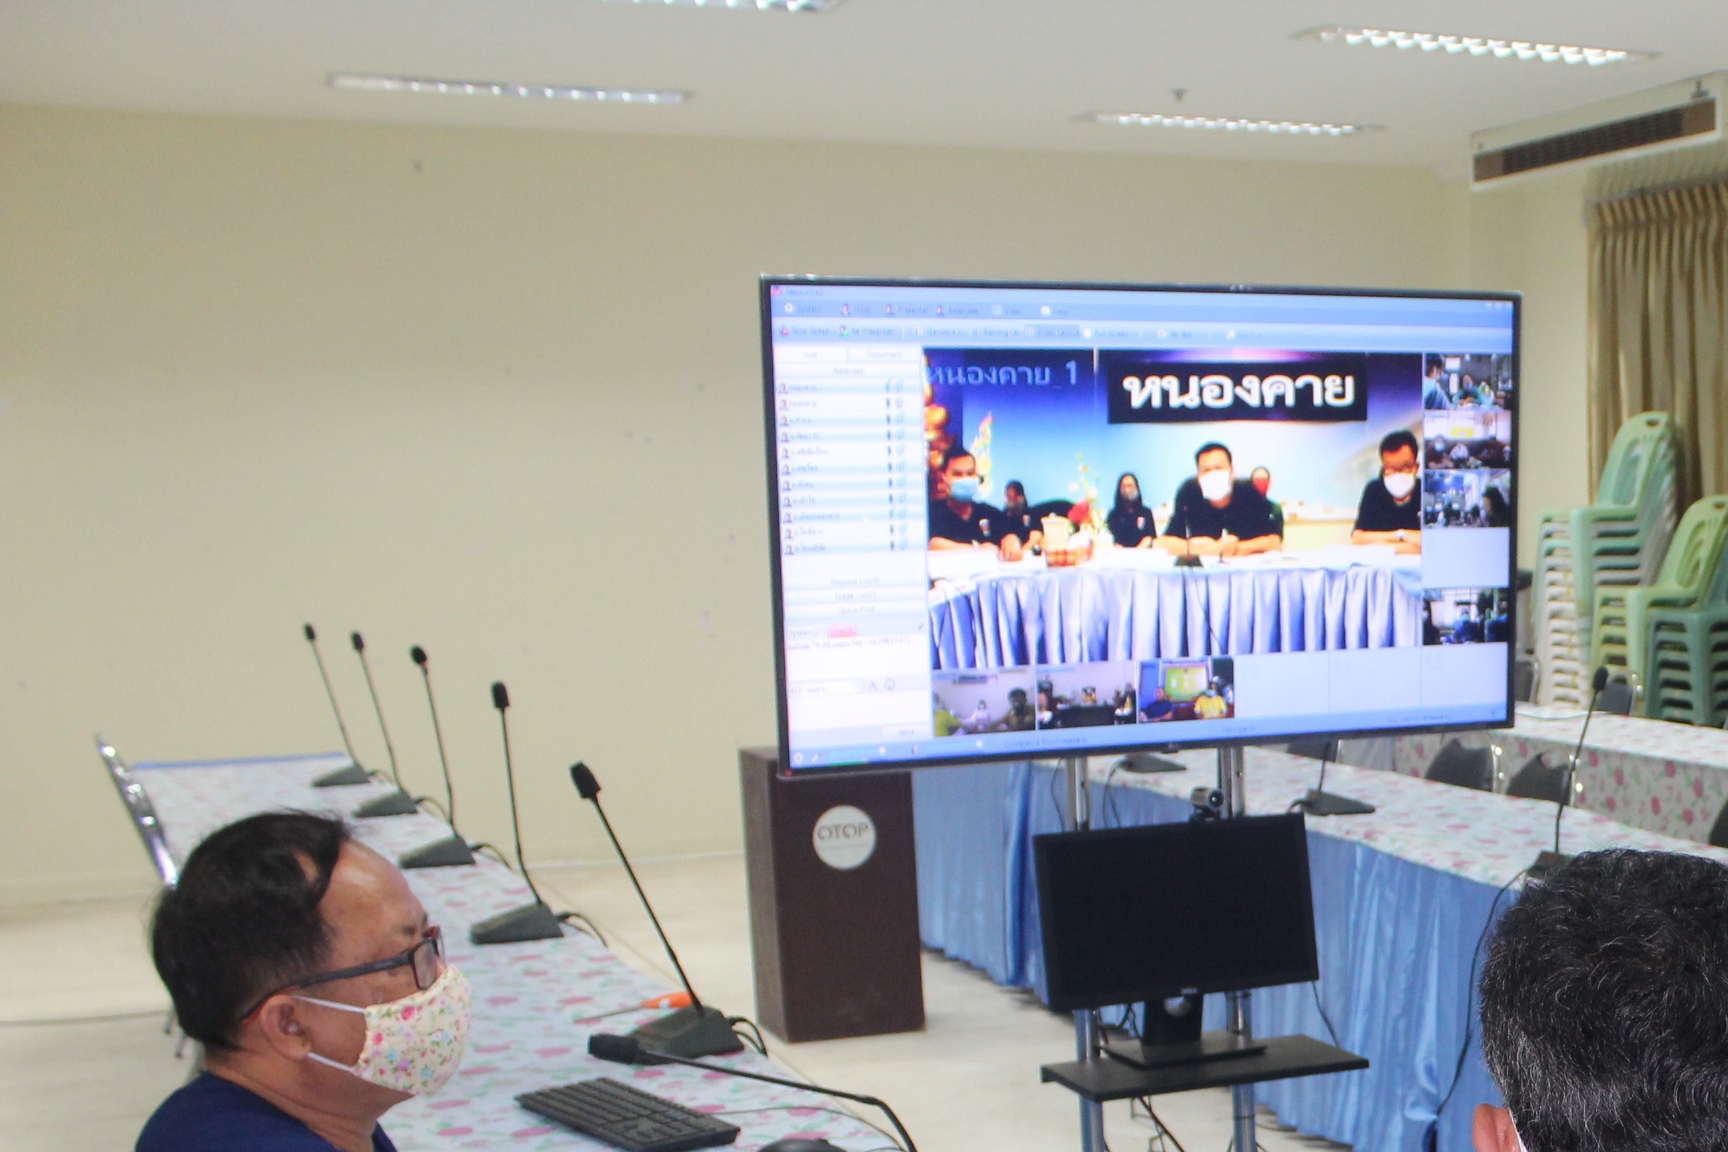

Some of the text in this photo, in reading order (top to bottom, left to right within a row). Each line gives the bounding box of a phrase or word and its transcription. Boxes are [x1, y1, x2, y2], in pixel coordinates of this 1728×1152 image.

[1122, 374, 1355, 409] หนองคาย
[816, 822, 870, 841] OTOP
